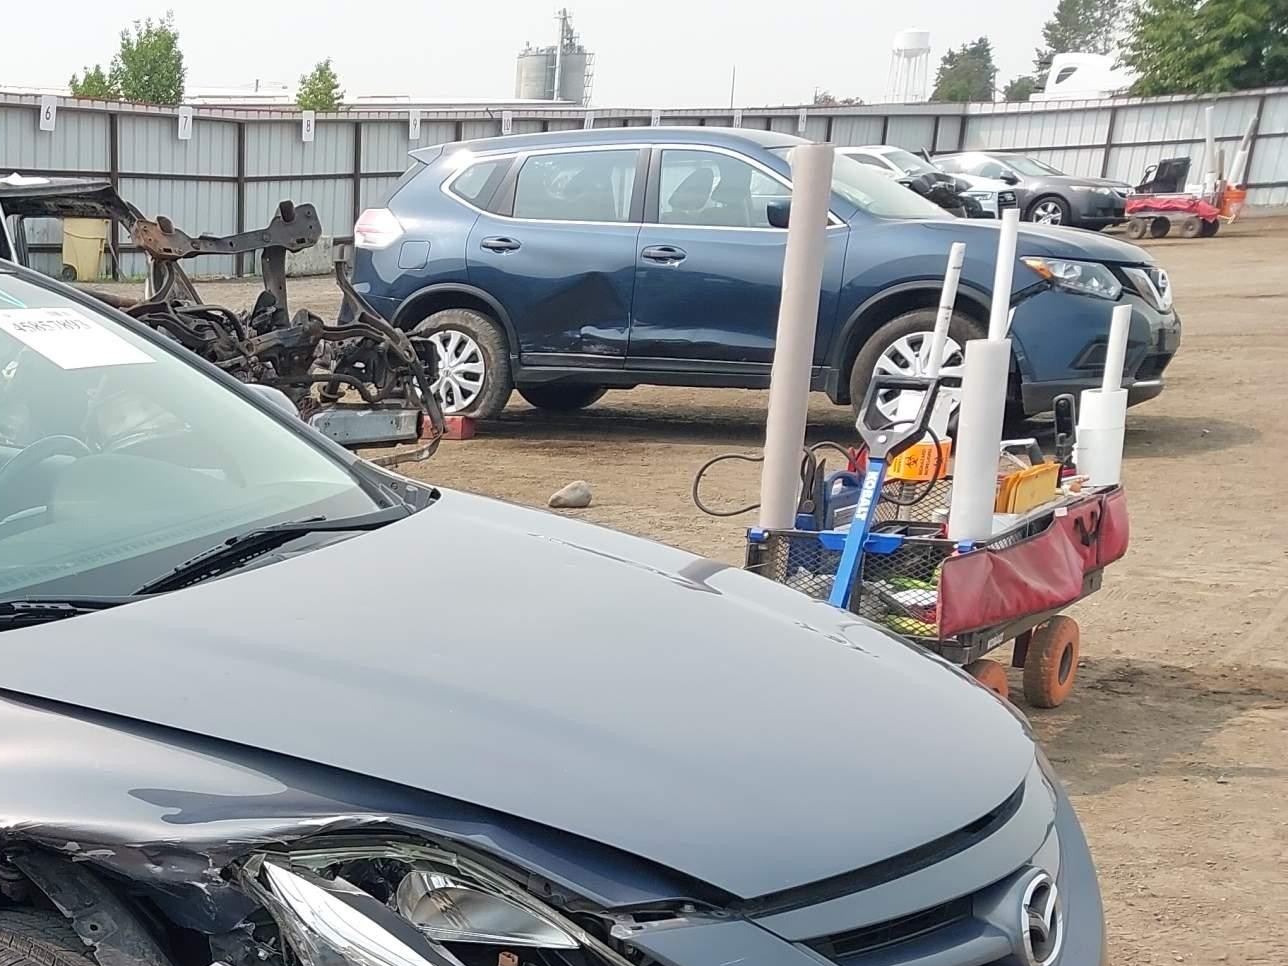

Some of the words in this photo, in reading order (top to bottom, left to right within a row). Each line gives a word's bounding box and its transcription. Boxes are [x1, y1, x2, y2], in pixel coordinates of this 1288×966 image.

[45, 107, 51, 120] 6
[183, 116, 189, 130] 7
[306, 119, 311, 132] 8
[412, 118, 418, 130] 9
[503, 118, 511, 130] 10
[855, 471, 880, 521] KOBALT
